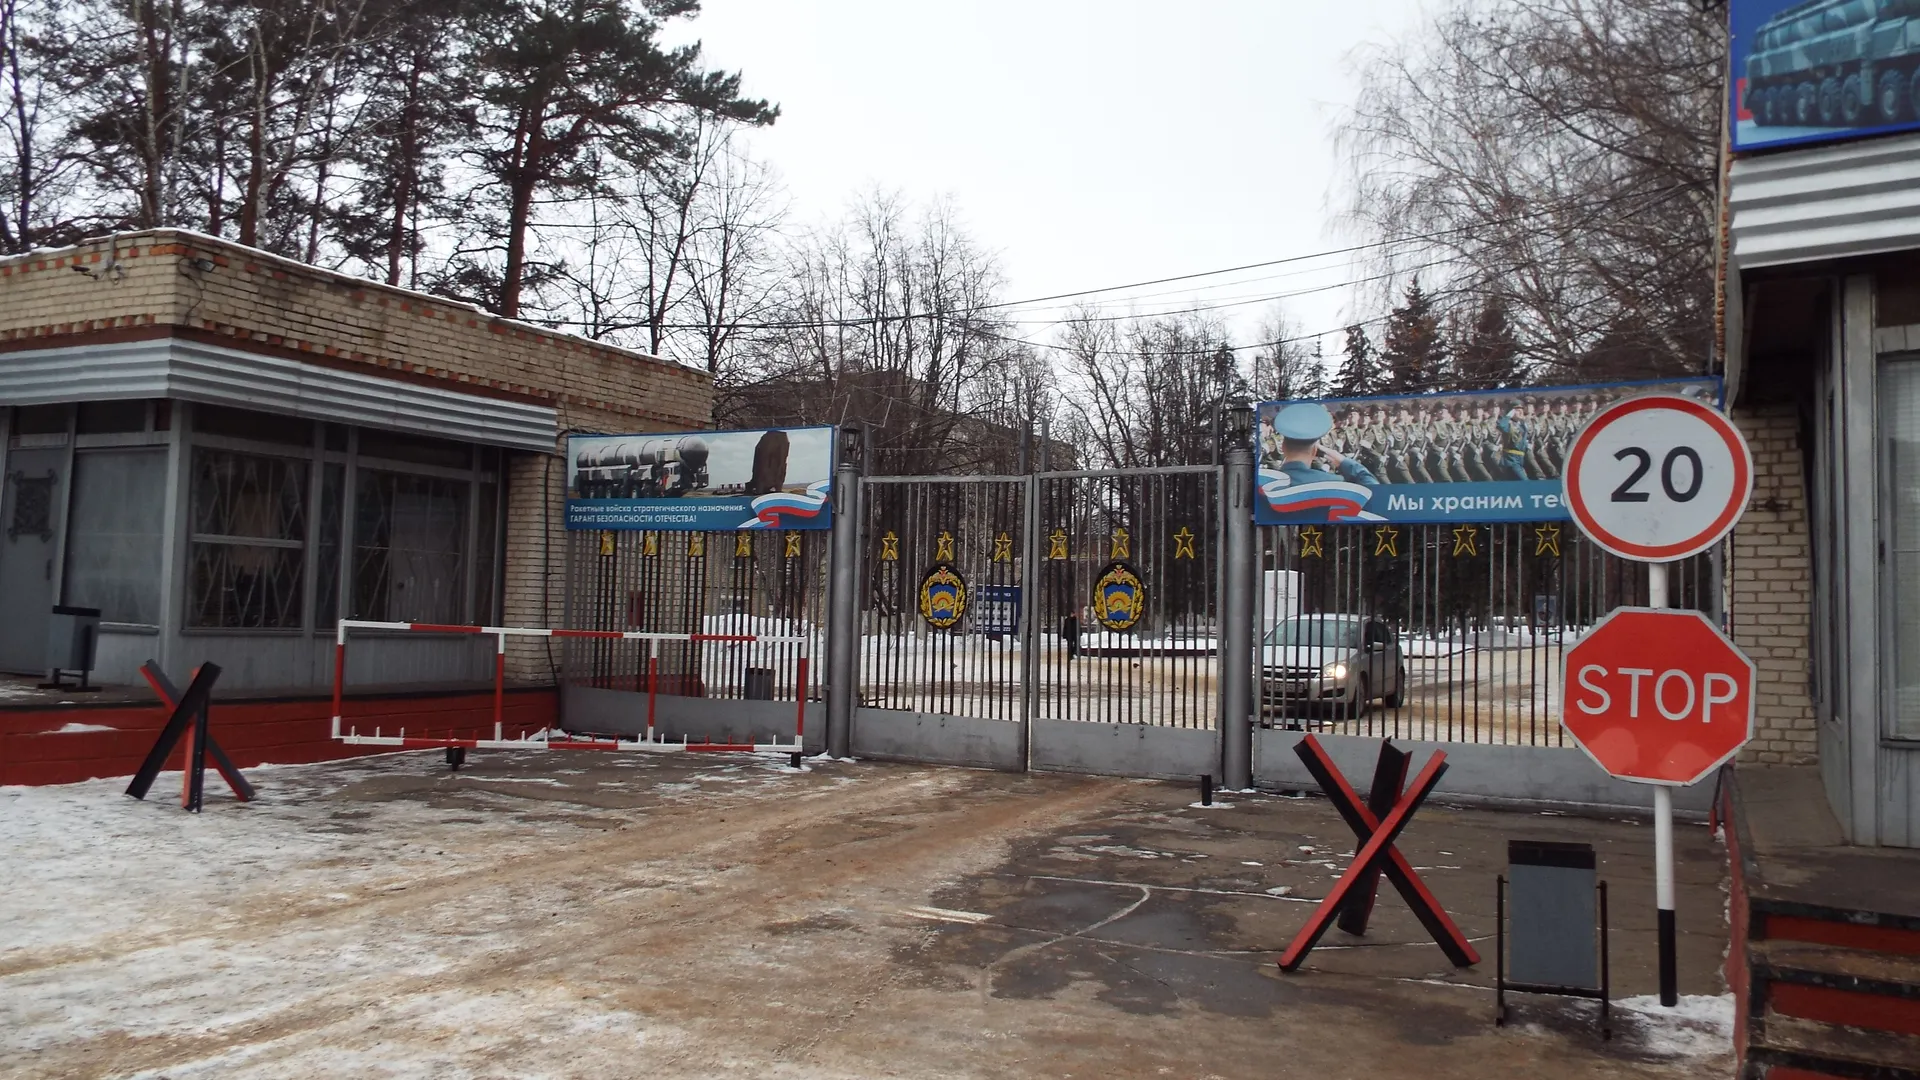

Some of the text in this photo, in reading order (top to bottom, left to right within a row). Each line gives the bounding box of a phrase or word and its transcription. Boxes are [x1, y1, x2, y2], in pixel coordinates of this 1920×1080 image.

[1611, 446, 1704, 503] 20
[570, 504, 604, 513] Ракетные
[606, 503, 632, 512] войска
[633, 504, 697, 514] стратегического
[1387, 493, 1424, 511] Мы
[1431, 495, 1524, 514] храним
[570, 513, 697, 523] ГАРАНТ БЕЗОПАСНОСТИ ОТЕЧЕСТВА!
[1576, 664, 1739, 723] STOP
